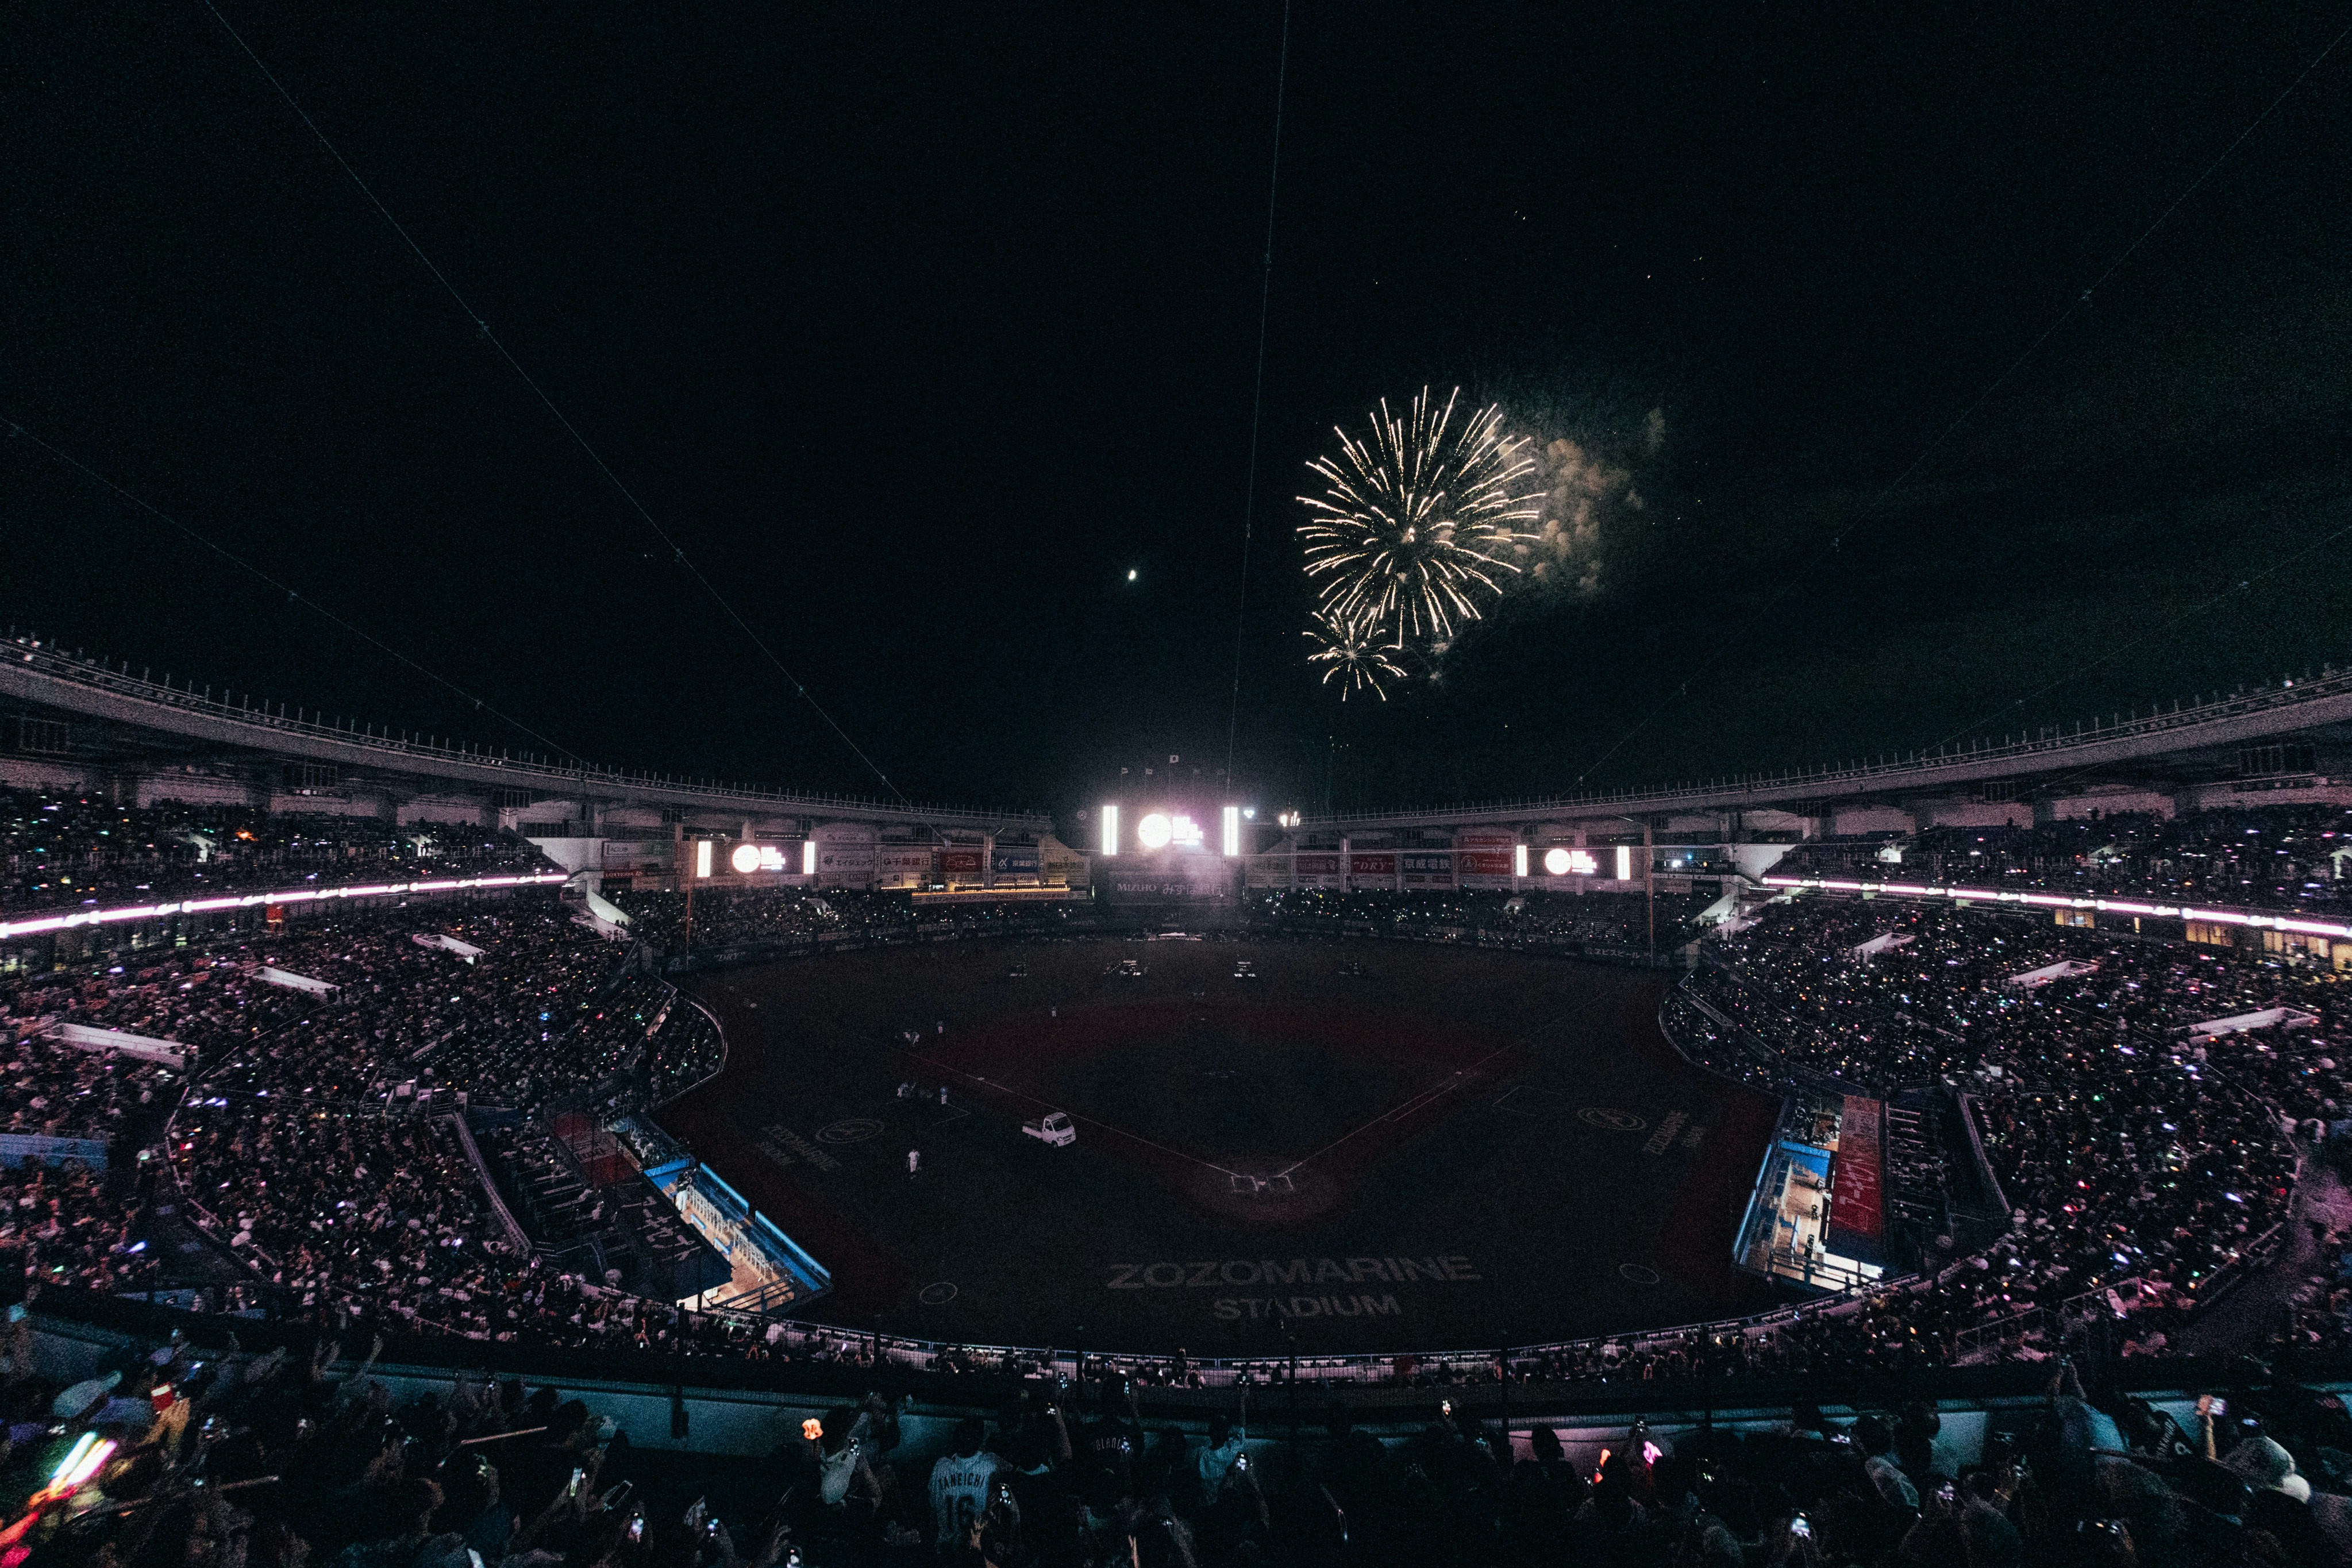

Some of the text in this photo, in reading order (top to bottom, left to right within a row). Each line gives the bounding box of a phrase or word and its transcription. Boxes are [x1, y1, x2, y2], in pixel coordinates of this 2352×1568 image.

[892, 857, 929, 866] 千葉銀行
[1404, 858, 1451, 869] 京成電鉄
[1117, 883, 1157, 892] MIZUHO
[1107, 1255, 1483, 1289] ZOZOMARINE
[1213, 1294, 1402, 1320] STADIUM
[938, 1472, 985, 1490] TANEICHI
[946, 1494, 976, 1531] 16
